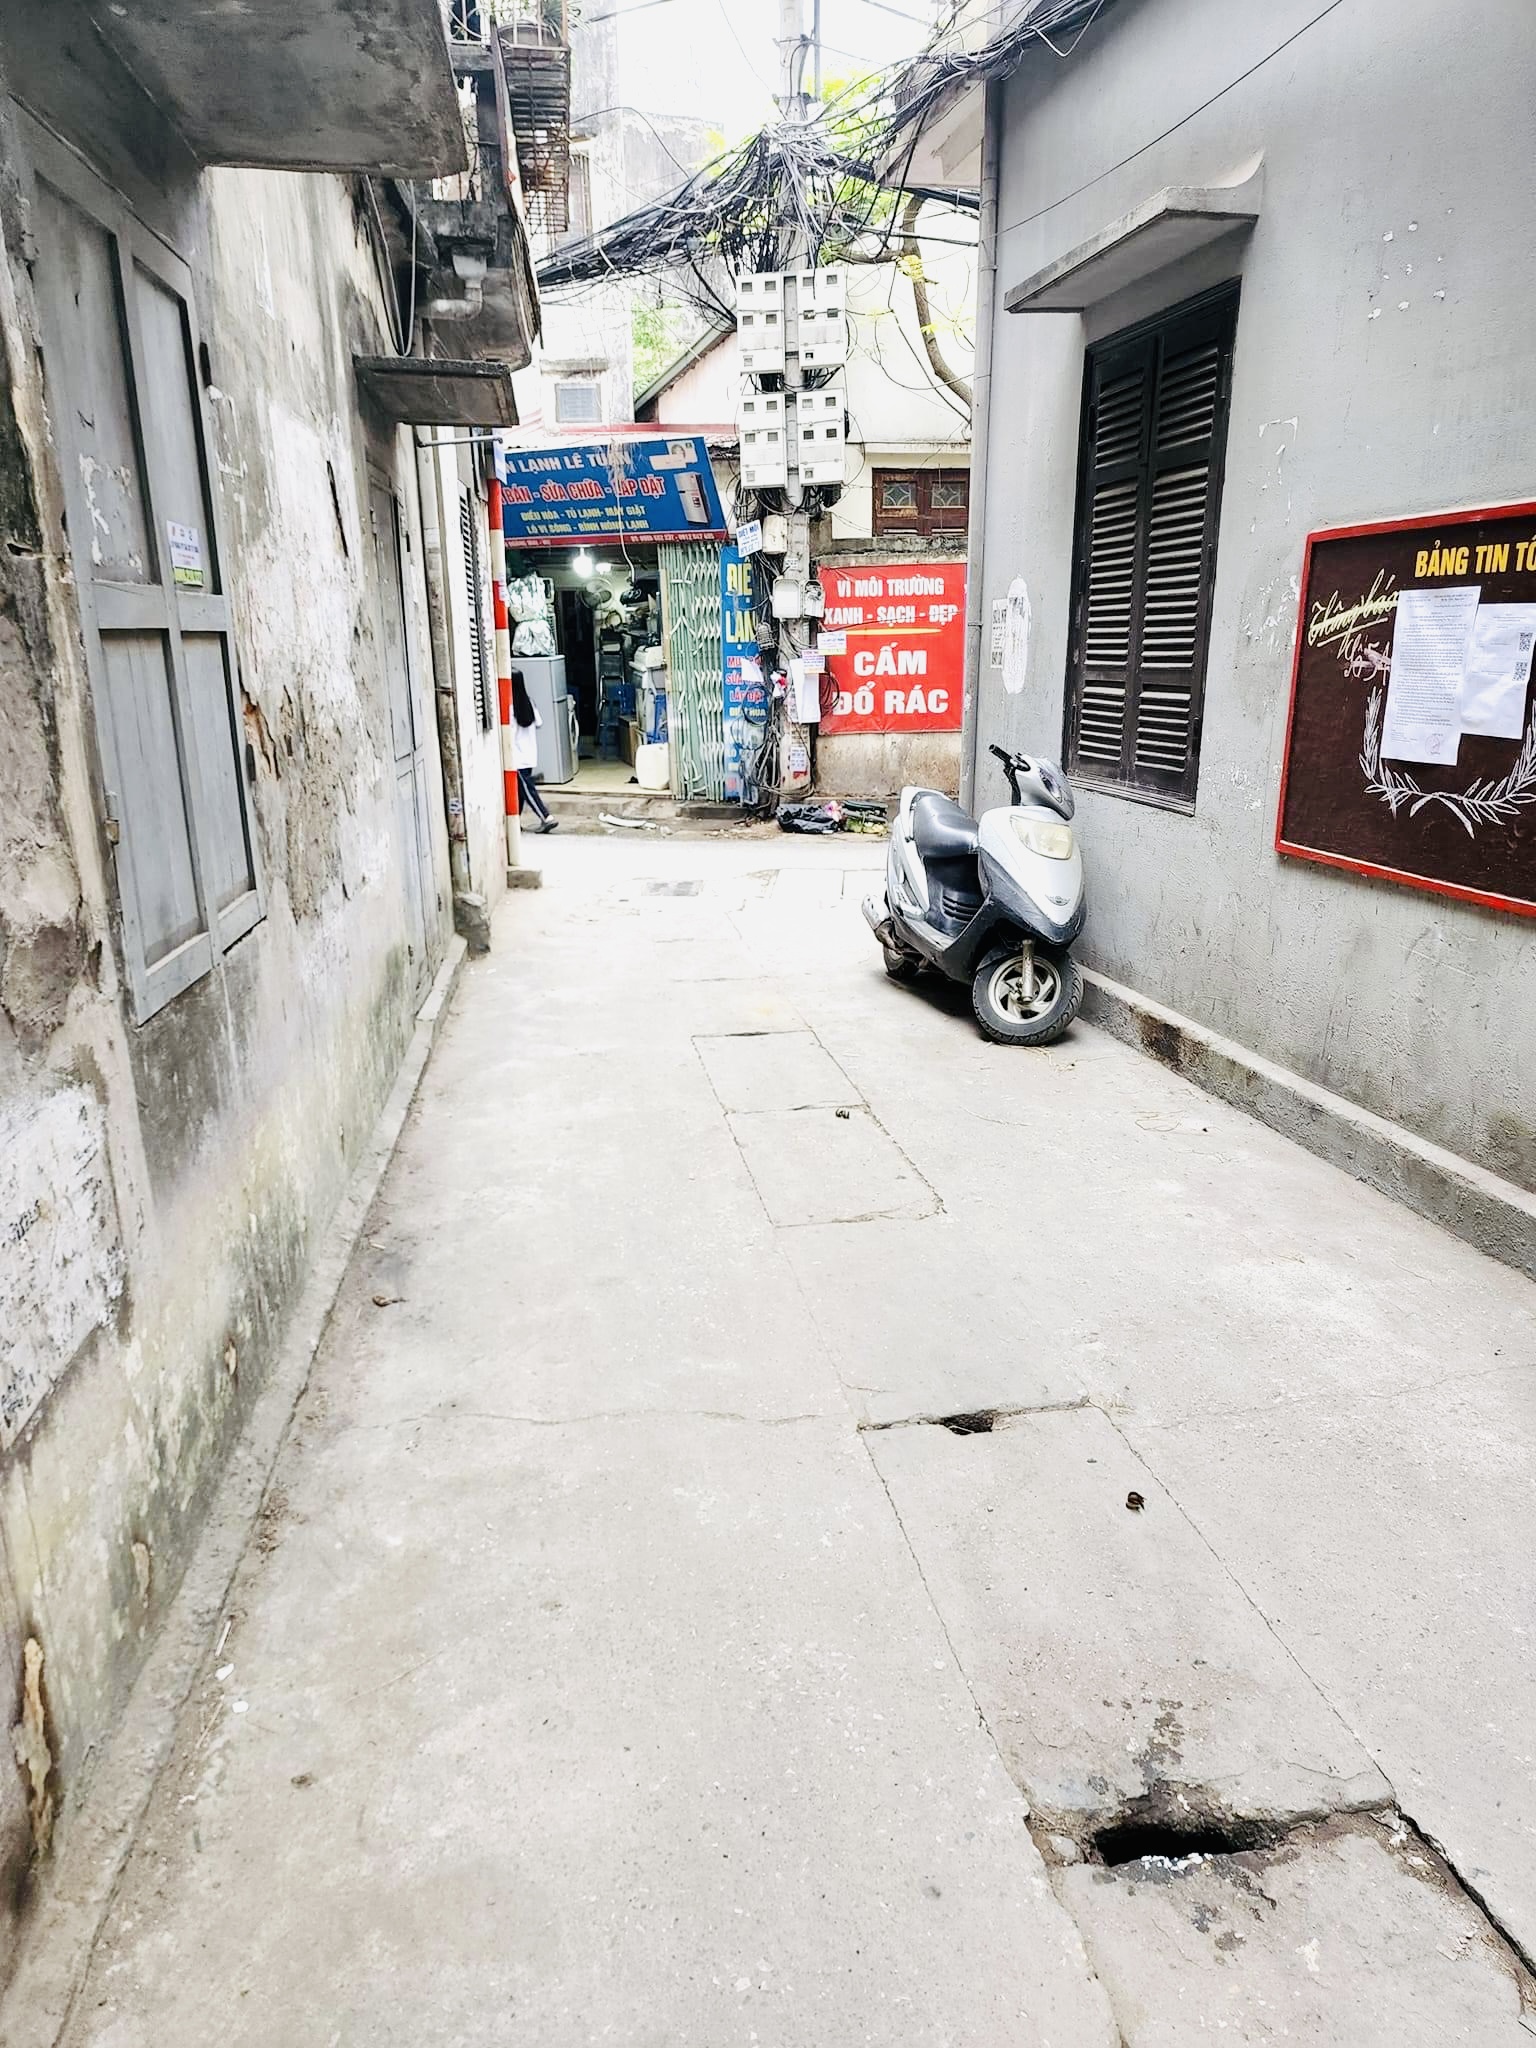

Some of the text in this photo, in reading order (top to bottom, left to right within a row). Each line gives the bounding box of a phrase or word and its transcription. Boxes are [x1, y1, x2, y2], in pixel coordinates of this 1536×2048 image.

[518, 456, 562, 474] LẠNH
[563, 451, 584, 469] LÊ
[586, 450, 632, 467] TUN
[506, 484, 534, 505] BÁN
[540, 479, 570, 502] SỬA
[568, 478, 605, 500] CHỮA
[638, 474, 666, 499] ĐẶT
[1414, 540, 1469, 578] BẢNG
[1475, 543, 1510, 575] TIN
[726, 556, 753, 603] ĐIỆ
[837, 576, 851, 597] VÌ
[855, 576, 883, 597] MÔI
[887, 573, 945, 596] TRƯỜNG
[725, 610, 759, 650] LẠN
[824, 607, 863, 624] XANH
[876, 605, 916, 627] SẠCH
[928, 604, 959, 626] ĐẸP
[854, 641, 928, 676] CẤM
[832, 681, 876, 715] ĐỔ
[884, 684, 949, 715] RÁC
